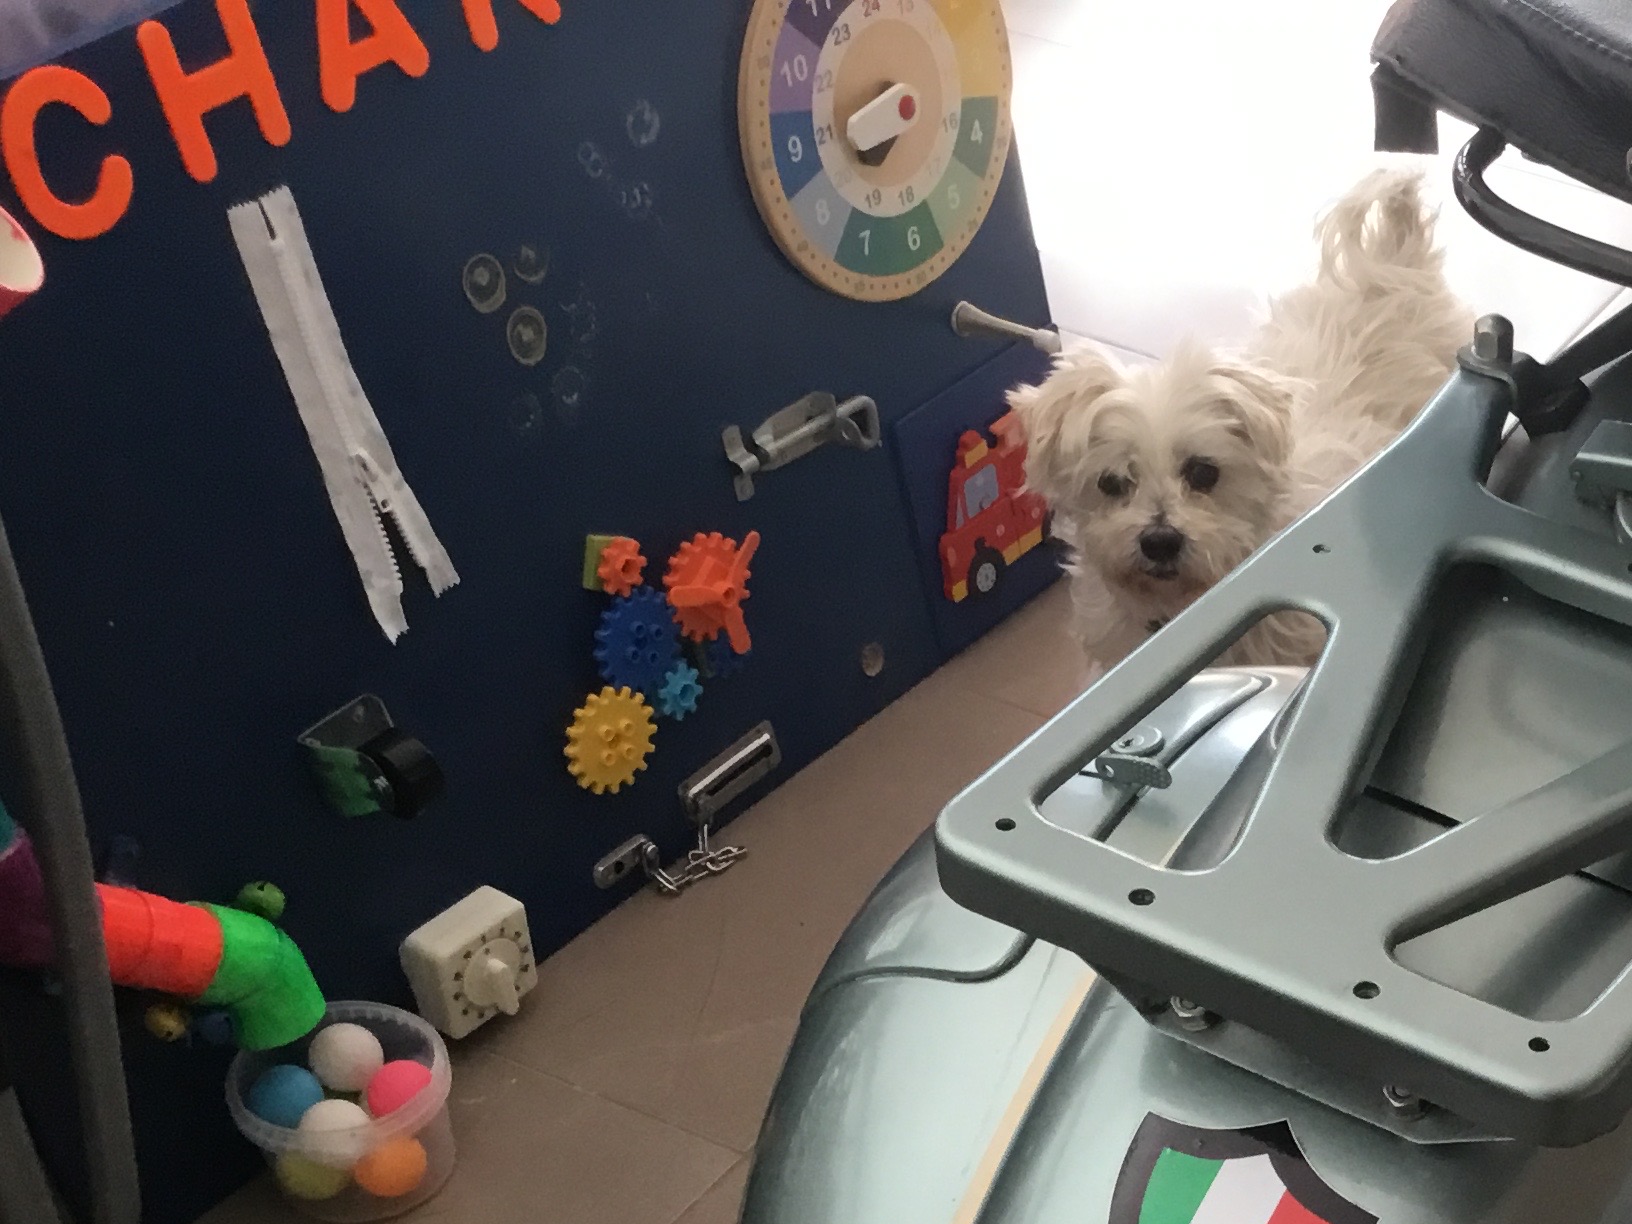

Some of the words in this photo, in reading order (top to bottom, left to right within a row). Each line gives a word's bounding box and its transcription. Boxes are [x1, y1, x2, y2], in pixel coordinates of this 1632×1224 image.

[832, 23, 851, 46] 23
[781, 54, 808, 87] 10
[816, 69, 833, 93] 22
[815, 124, 833, 146] 21
[943, 112, 958, 134] 16
[970, 118, 984, 144] 4
[787, 135, 803, 163] 9
[864, 188, 882, 209] 19
[898, 185, 915, 207] 18
[947, 183, 960, 210] 5
[815, 198, 831, 226] 8
[907, 226, 921, 251] 6
